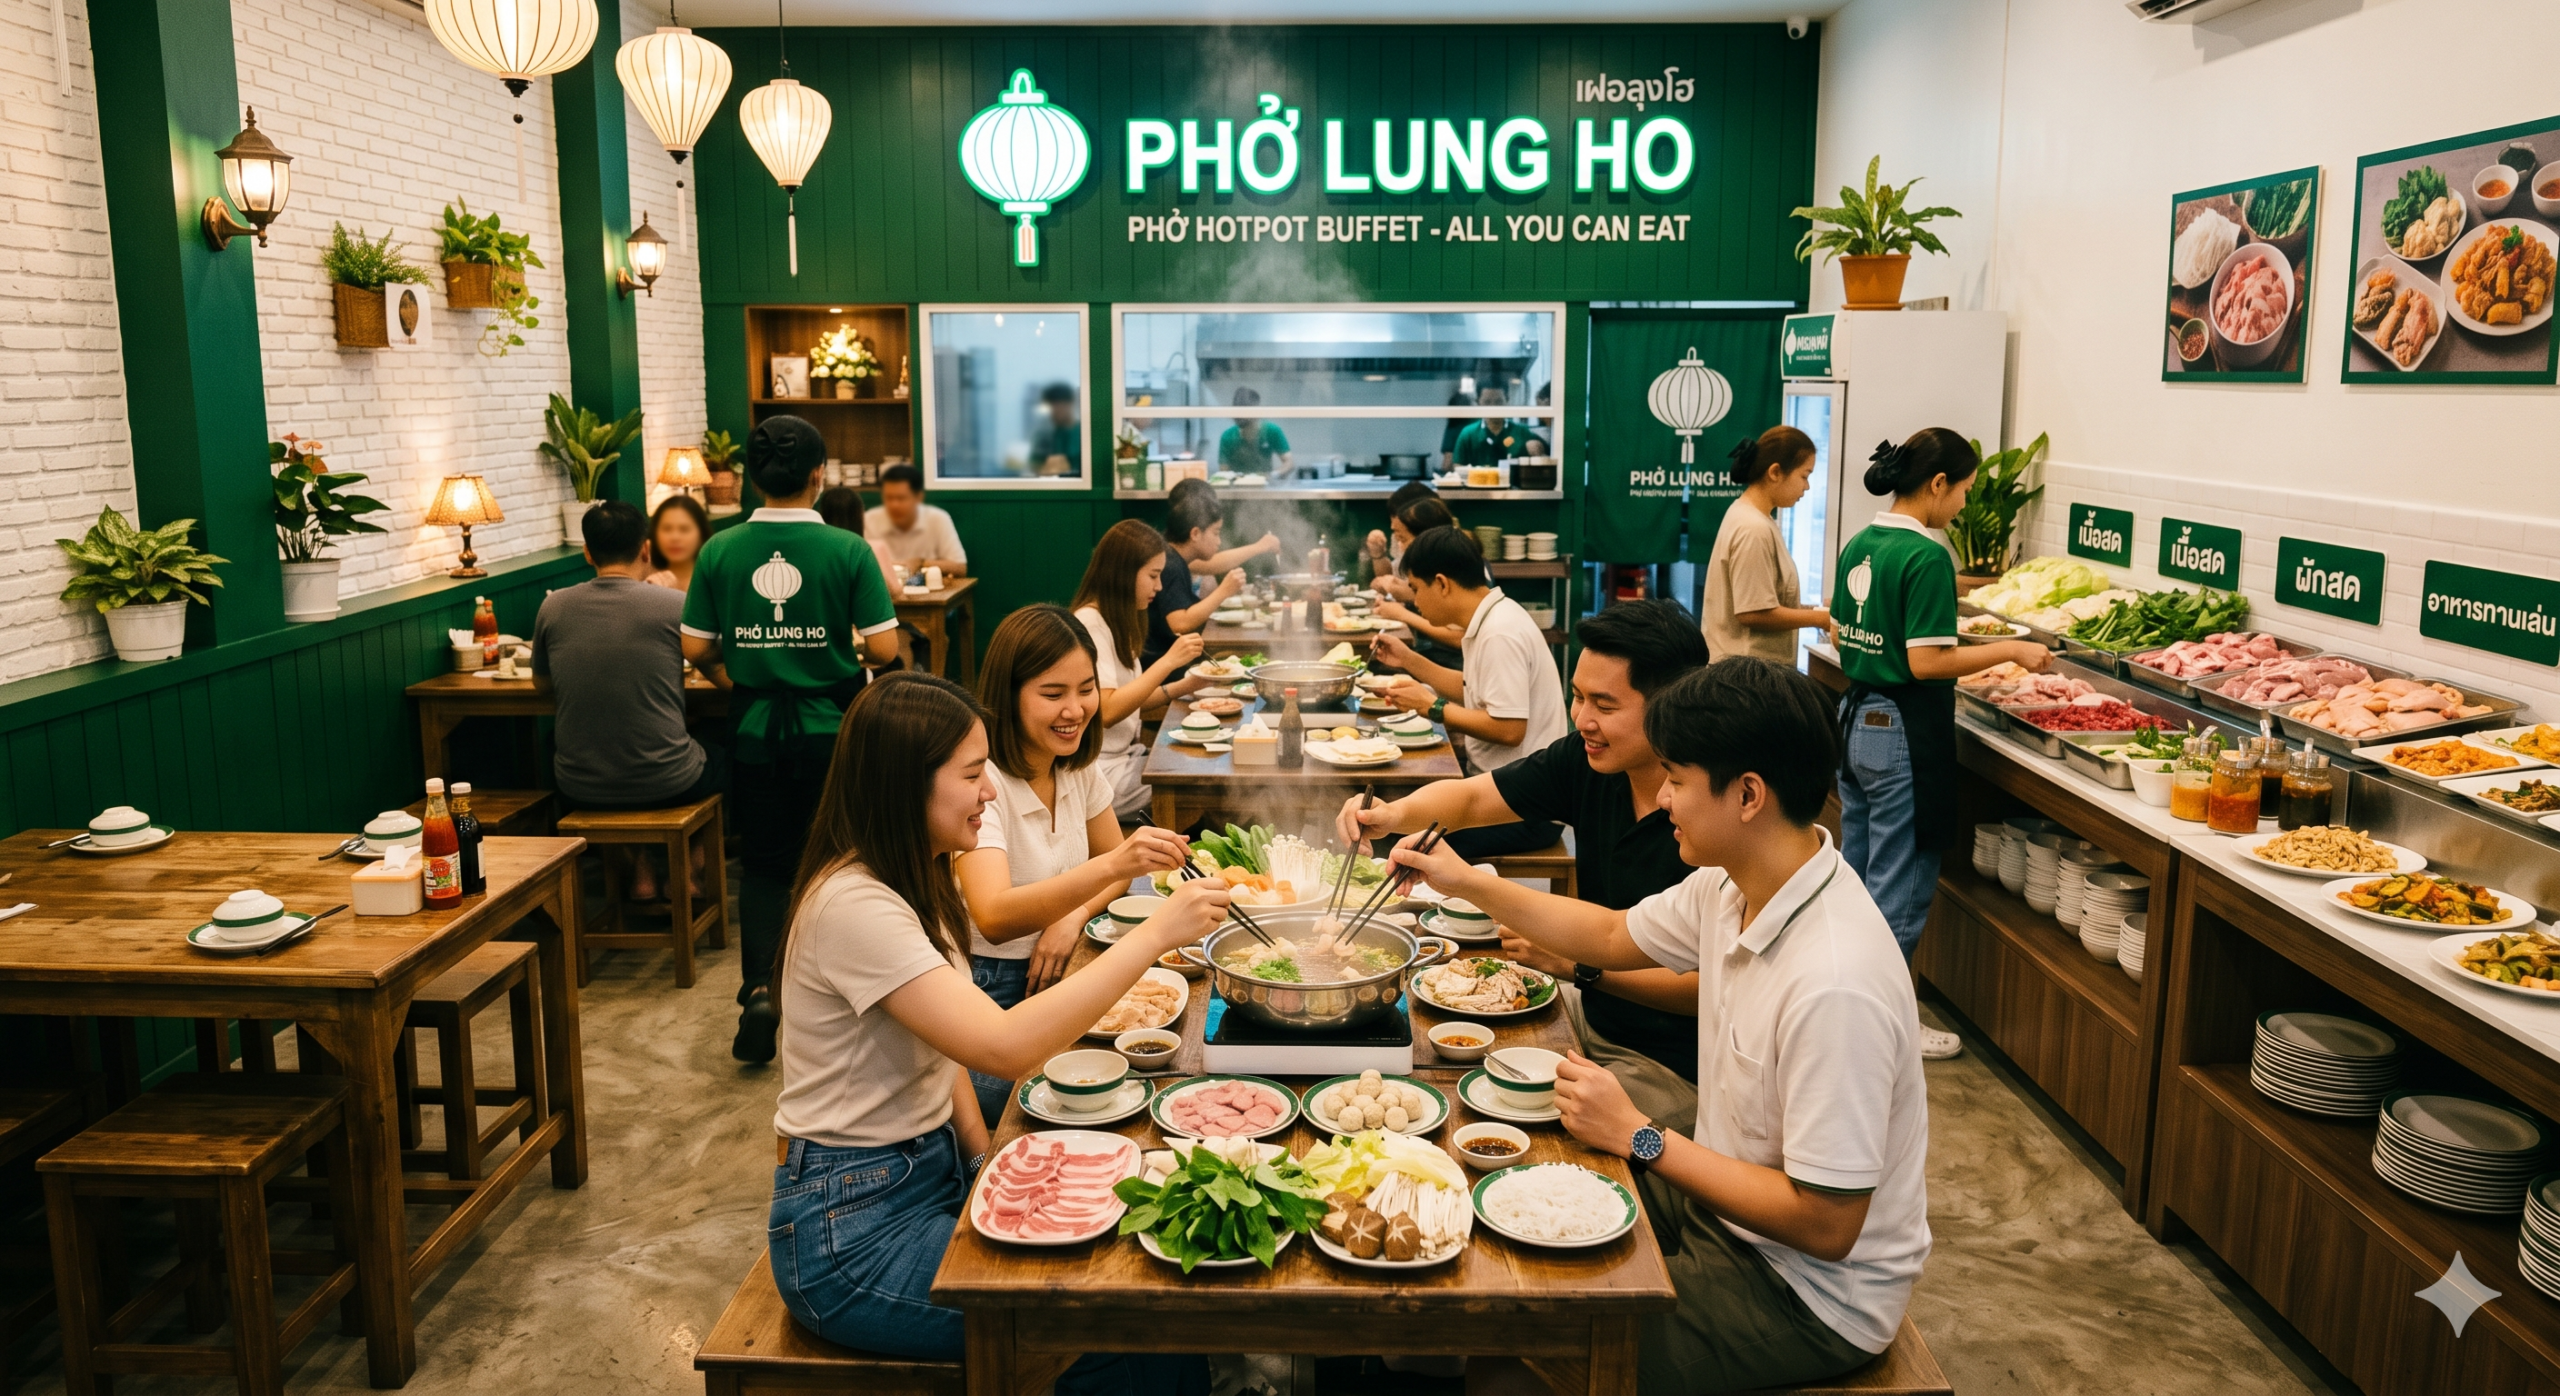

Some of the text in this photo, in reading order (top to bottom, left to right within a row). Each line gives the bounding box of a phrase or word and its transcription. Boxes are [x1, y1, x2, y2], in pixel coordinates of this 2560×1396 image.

[1576, 66, 1695, 112] เฝอลุงโฮ
[1126, 92, 1696, 195] PHỞ LUNG HO
[1128, 208, 1190, 242] PHỞ
[1196, 215, 1309, 243] HOTPOT
[1316, 215, 1423, 243] BUFFET
[1445, 215, 1499, 242] ALL
[1505, 214, 1564, 242] YOU
[1571, 214, 1630, 242] CAN
[1638, 214, 1691, 242] EAT
[1670, 471, 1715, 486] LUNG
[2078, 509, 2123, 554] เนื้อสด
[2170, 525, 2226, 576] เนื้อสด
[2295, 556, 2361, 603] ผักสด
[766, 627, 803, 639] LUNG
[806, 627, 825, 639] HO
[2427, 592, 2557, 637] อาหารทานเล่น
[1865, 633, 1884, 646] HO
